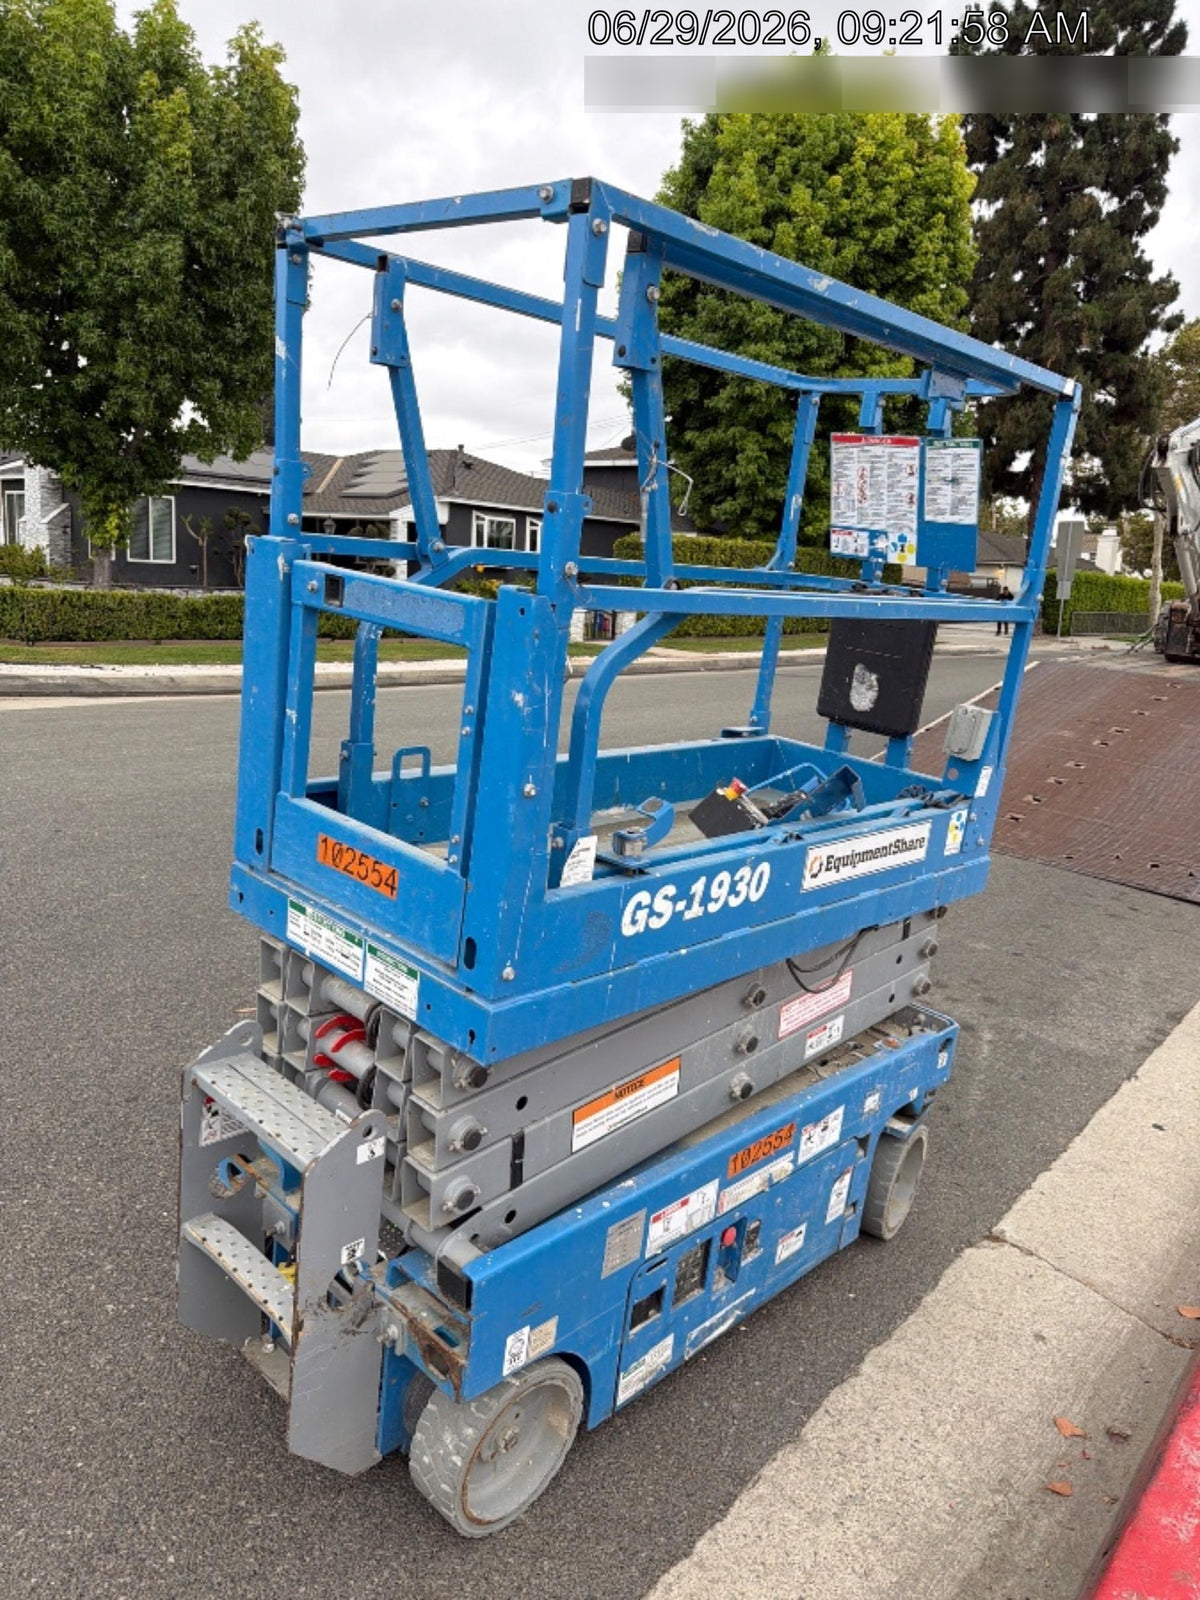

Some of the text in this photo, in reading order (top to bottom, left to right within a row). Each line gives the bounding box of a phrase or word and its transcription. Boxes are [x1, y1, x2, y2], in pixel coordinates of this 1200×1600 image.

[321, 836, 398, 896] 102554
[825, 837, 925, 873] EquipmentShare
[621, 862, 771, 937] GS-1930
